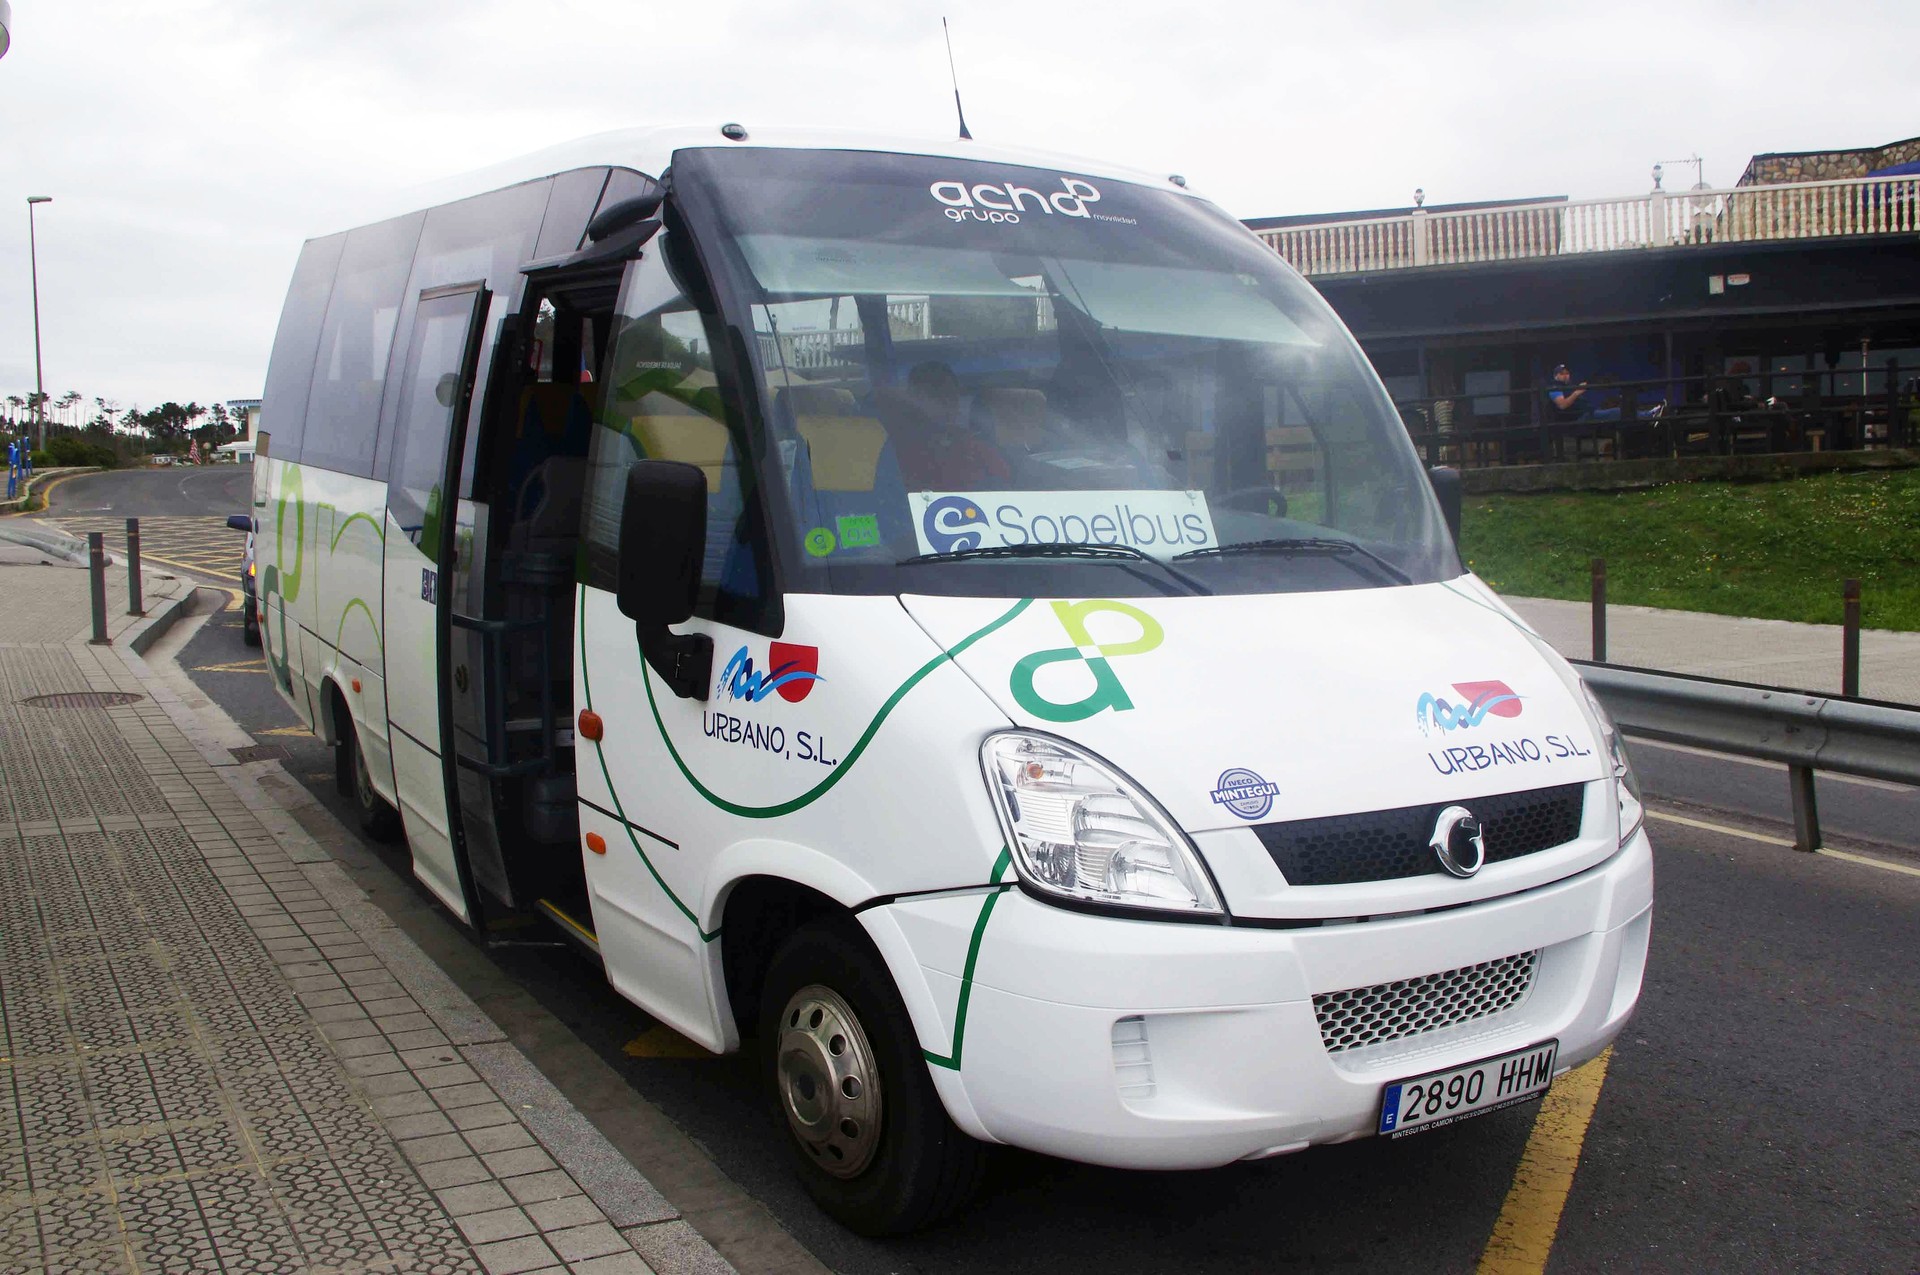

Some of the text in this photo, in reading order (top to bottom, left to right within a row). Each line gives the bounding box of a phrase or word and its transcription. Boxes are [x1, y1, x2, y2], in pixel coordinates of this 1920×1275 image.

[944, 208, 1020, 224] grupo
[995, 504, 1208, 546] Sopelbus
[703, 711, 837, 766] URBANO, S.L.
[1428, 735, 1591, 775] URBANO, S.L.
[1213, 784, 1277, 802] MINTEGUI
[1228, 778, 1253, 787] IVECO
[1402, 1069, 1485, 1122] 2890
[1496, 1049, 1552, 1097] HHM
[1386, 1113, 1394, 1124] E
[1392, 1127, 1420, 1139] MINTEGUI
[1431, 1117, 1454, 1129] CAMION
